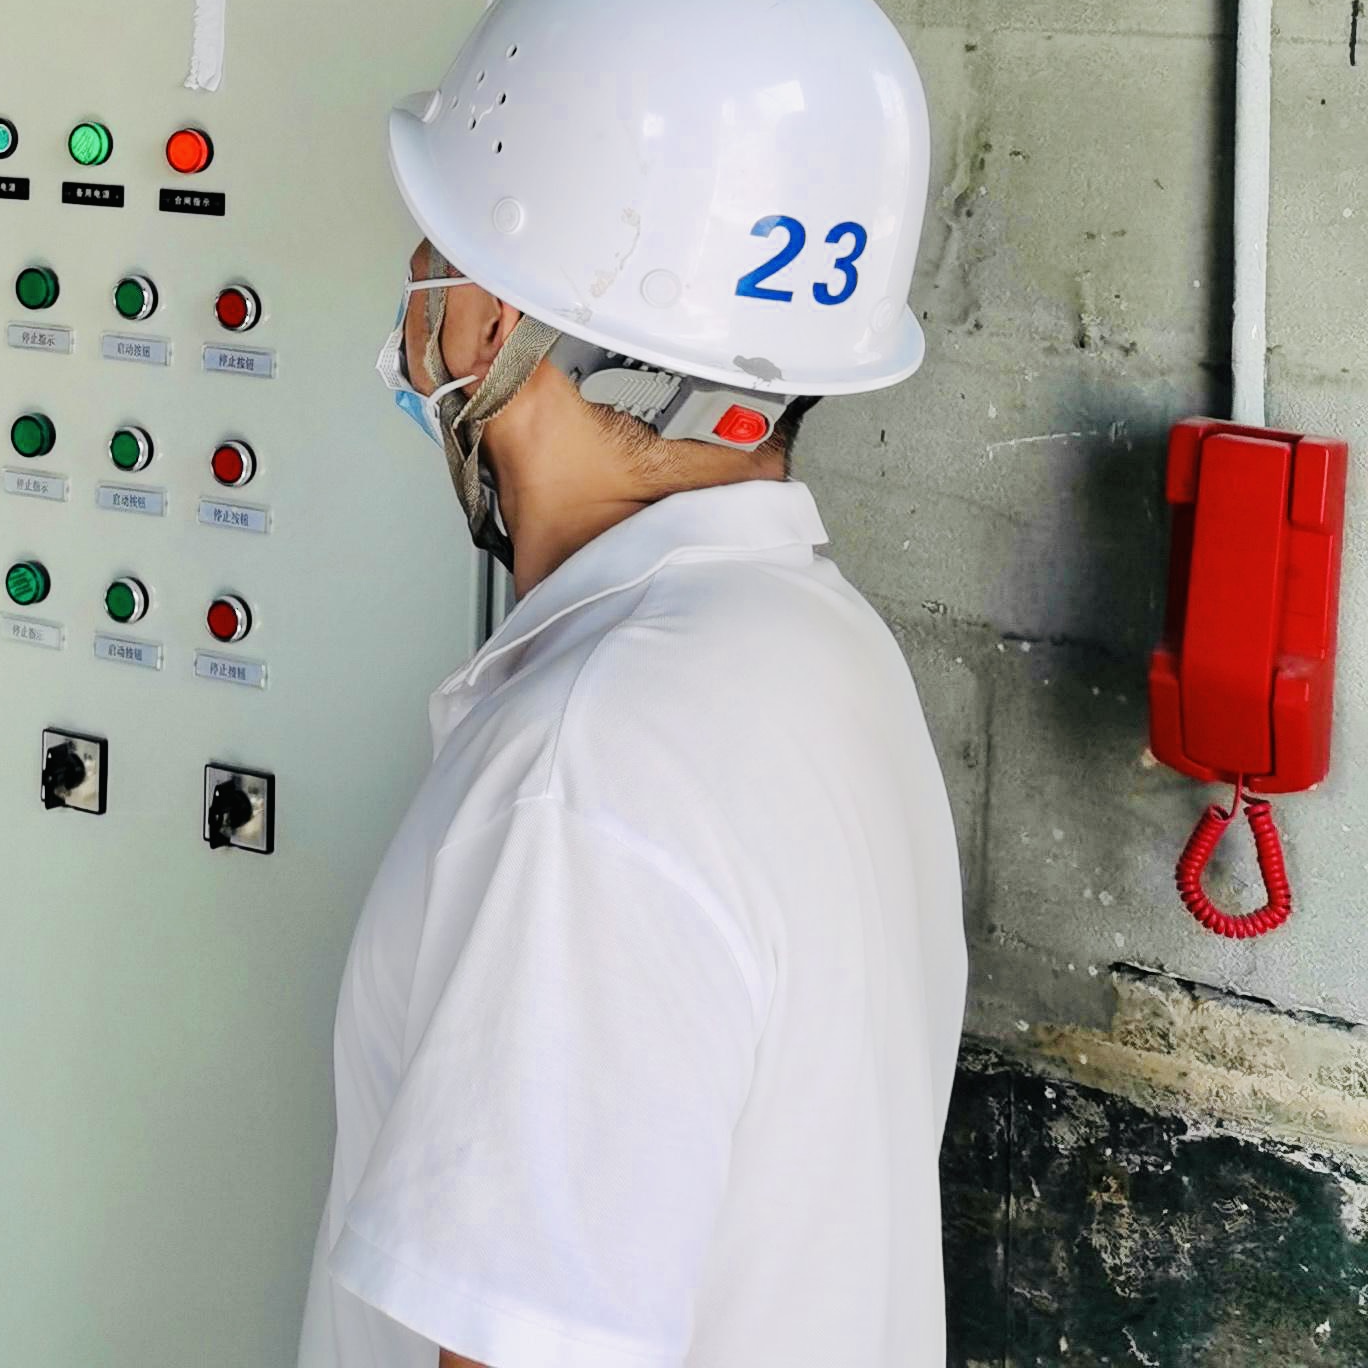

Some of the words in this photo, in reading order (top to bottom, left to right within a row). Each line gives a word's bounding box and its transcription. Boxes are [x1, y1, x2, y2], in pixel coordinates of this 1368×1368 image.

[735, 214, 867, 305] 23
[117, 342, 151, 359] 启动按钮
[218, 353, 254, 372] 停止按钮
[213, 508, 249, 527] 停止按钮
[108, 644, 143, 662] 启动按钮
[210, 661, 246, 681] 停止按钮
